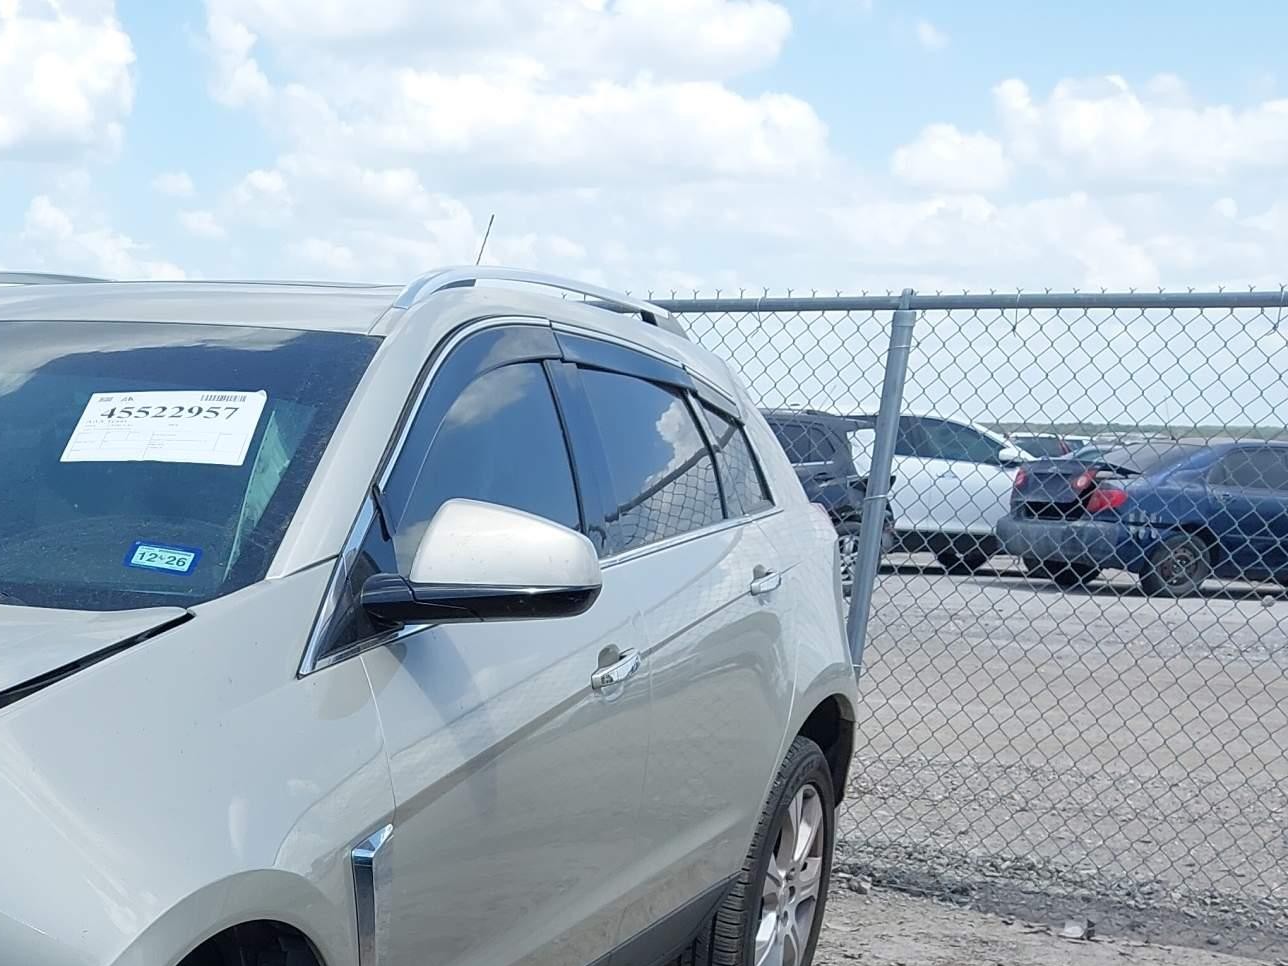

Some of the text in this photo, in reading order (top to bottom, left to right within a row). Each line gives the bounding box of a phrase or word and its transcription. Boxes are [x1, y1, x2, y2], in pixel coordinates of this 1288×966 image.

[100, 405, 240, 420] 45522957
[138, 551, 158, 563] 12
[165, 555, 188, 567] 26
